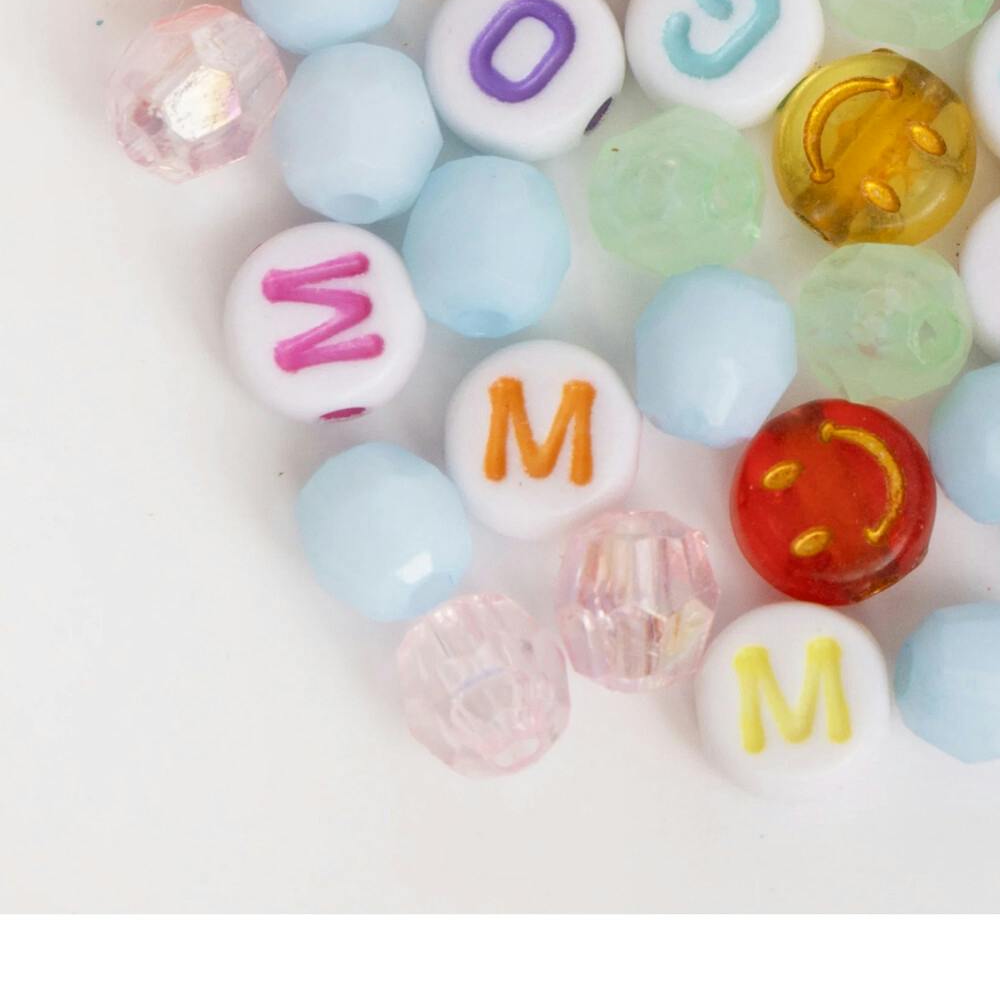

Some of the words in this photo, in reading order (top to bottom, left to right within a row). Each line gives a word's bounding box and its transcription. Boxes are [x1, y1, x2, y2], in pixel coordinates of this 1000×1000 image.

[261, 252, 384, 373] M
[483, 376, 597, 487] M
[732, 636, 853, 755] M
